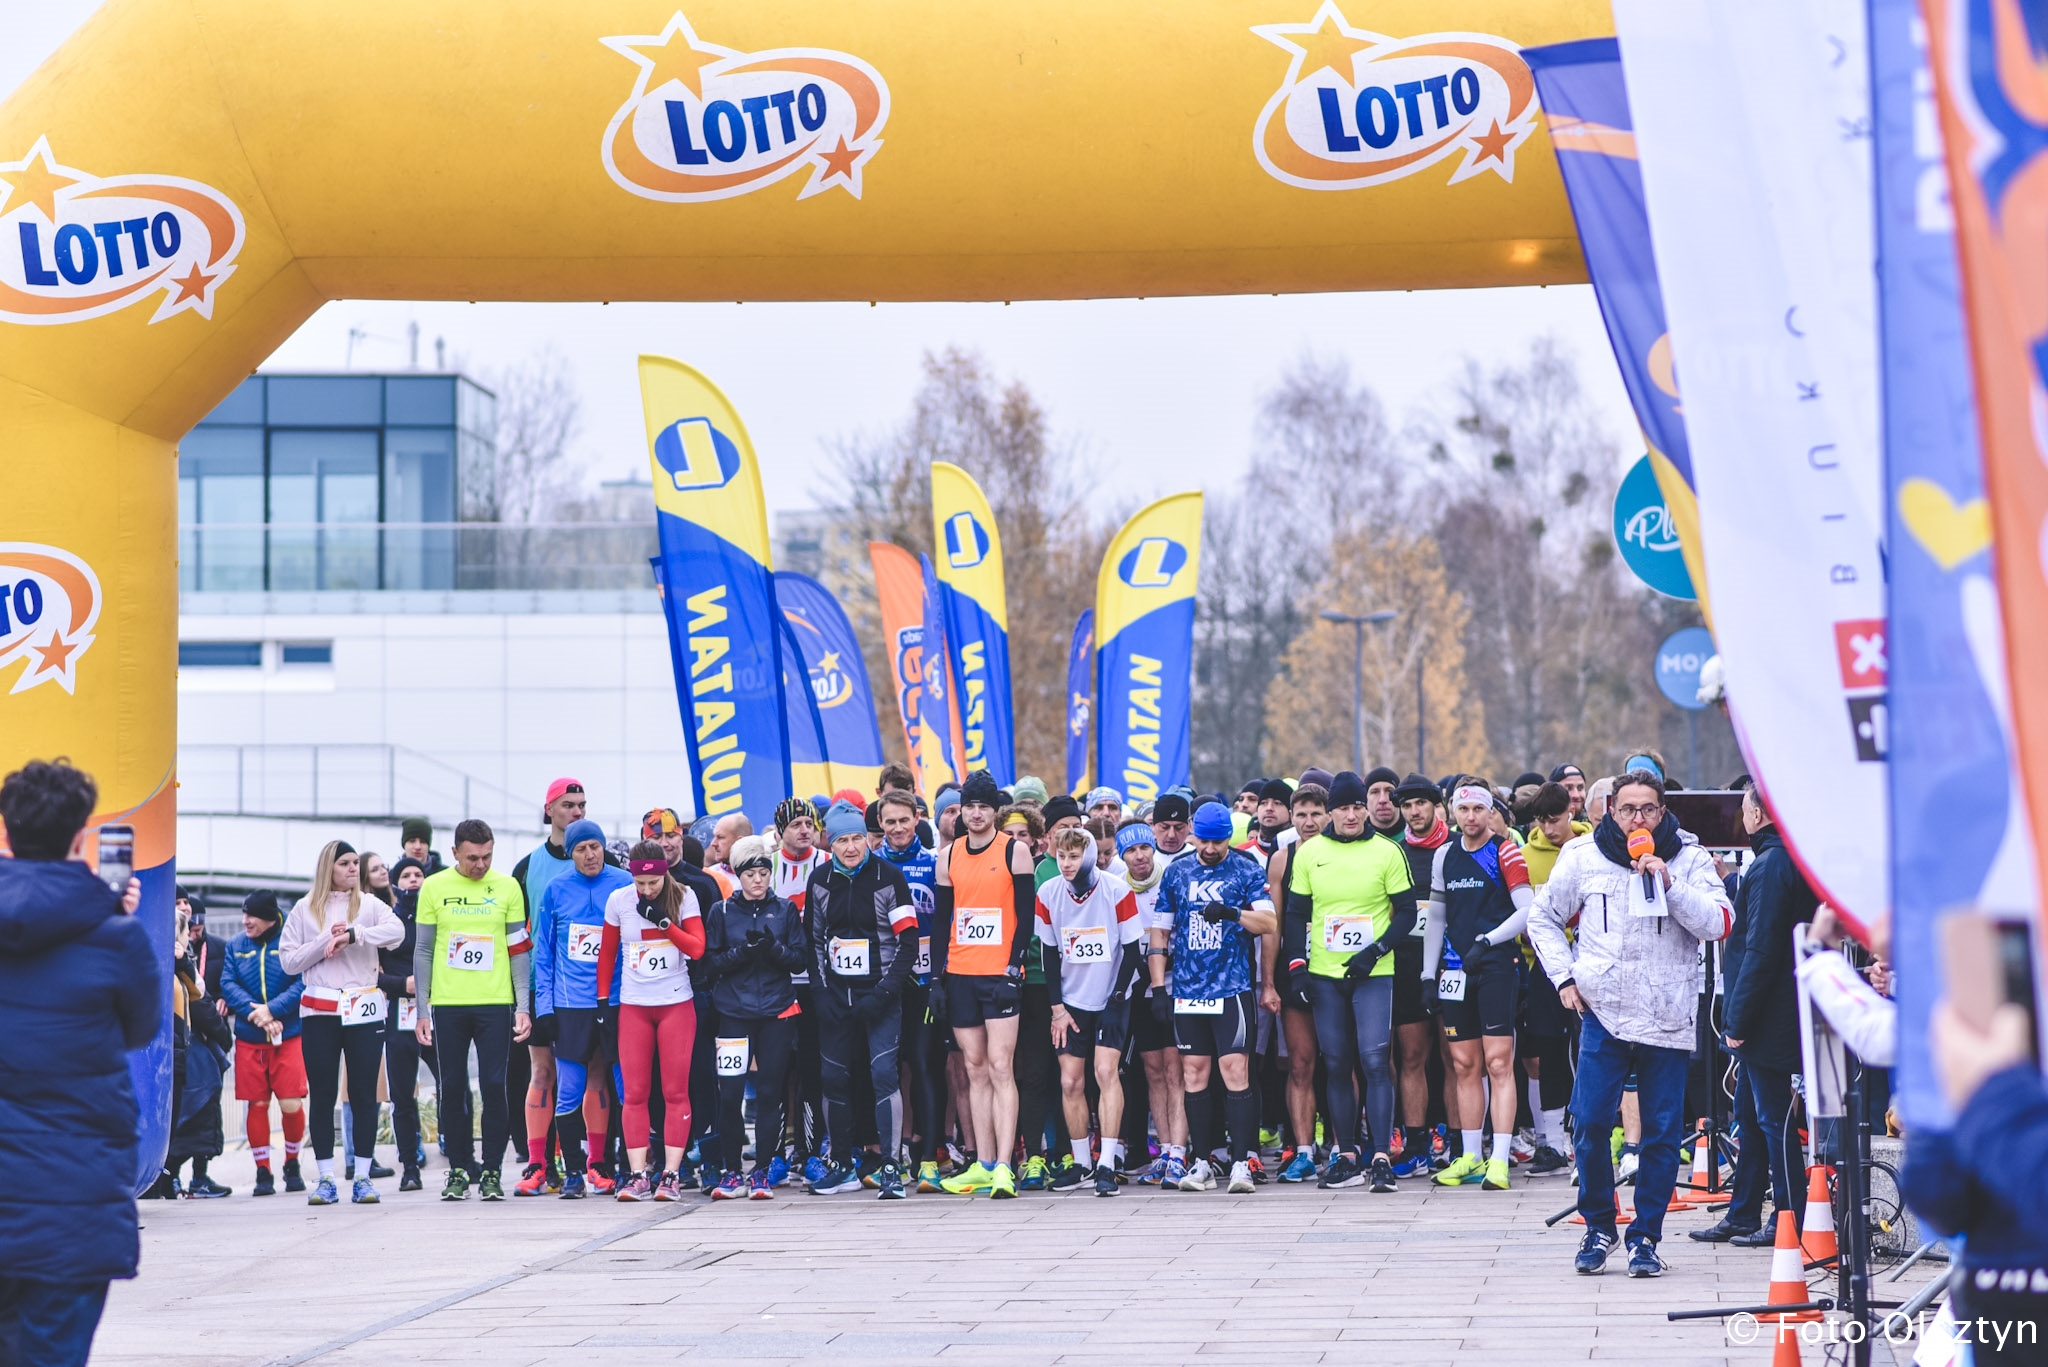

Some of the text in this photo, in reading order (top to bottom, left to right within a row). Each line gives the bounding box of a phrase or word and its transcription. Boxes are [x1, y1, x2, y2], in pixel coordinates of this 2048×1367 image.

[1317, 67, 1480, 153] LOTTO
[665, 83, 826, 165] LOTTO
[19, 211, 181, 286] LOTTO
[443, 896, 498, 906] RLX
[452, 907, 492, 915] RACING
[967, 925, 995, 939] 207
[1189, 930, 1222, 941] RUN
[1343, 932, 1362, 946] 52
[582, 942, 600, 956] 26
[1075, 943, 1104, 957] 333
[1188, 941, 1221, 950] ULTRA
[463, 950, 483, 965] 89
[649, 957, 668, 971] 91
[836, 955, 862, 969] 114
[1440, 979, 1461, 993] 367
[361, 1002, 377, 1017] 20
[718, 1056, 742, 1069] 128
